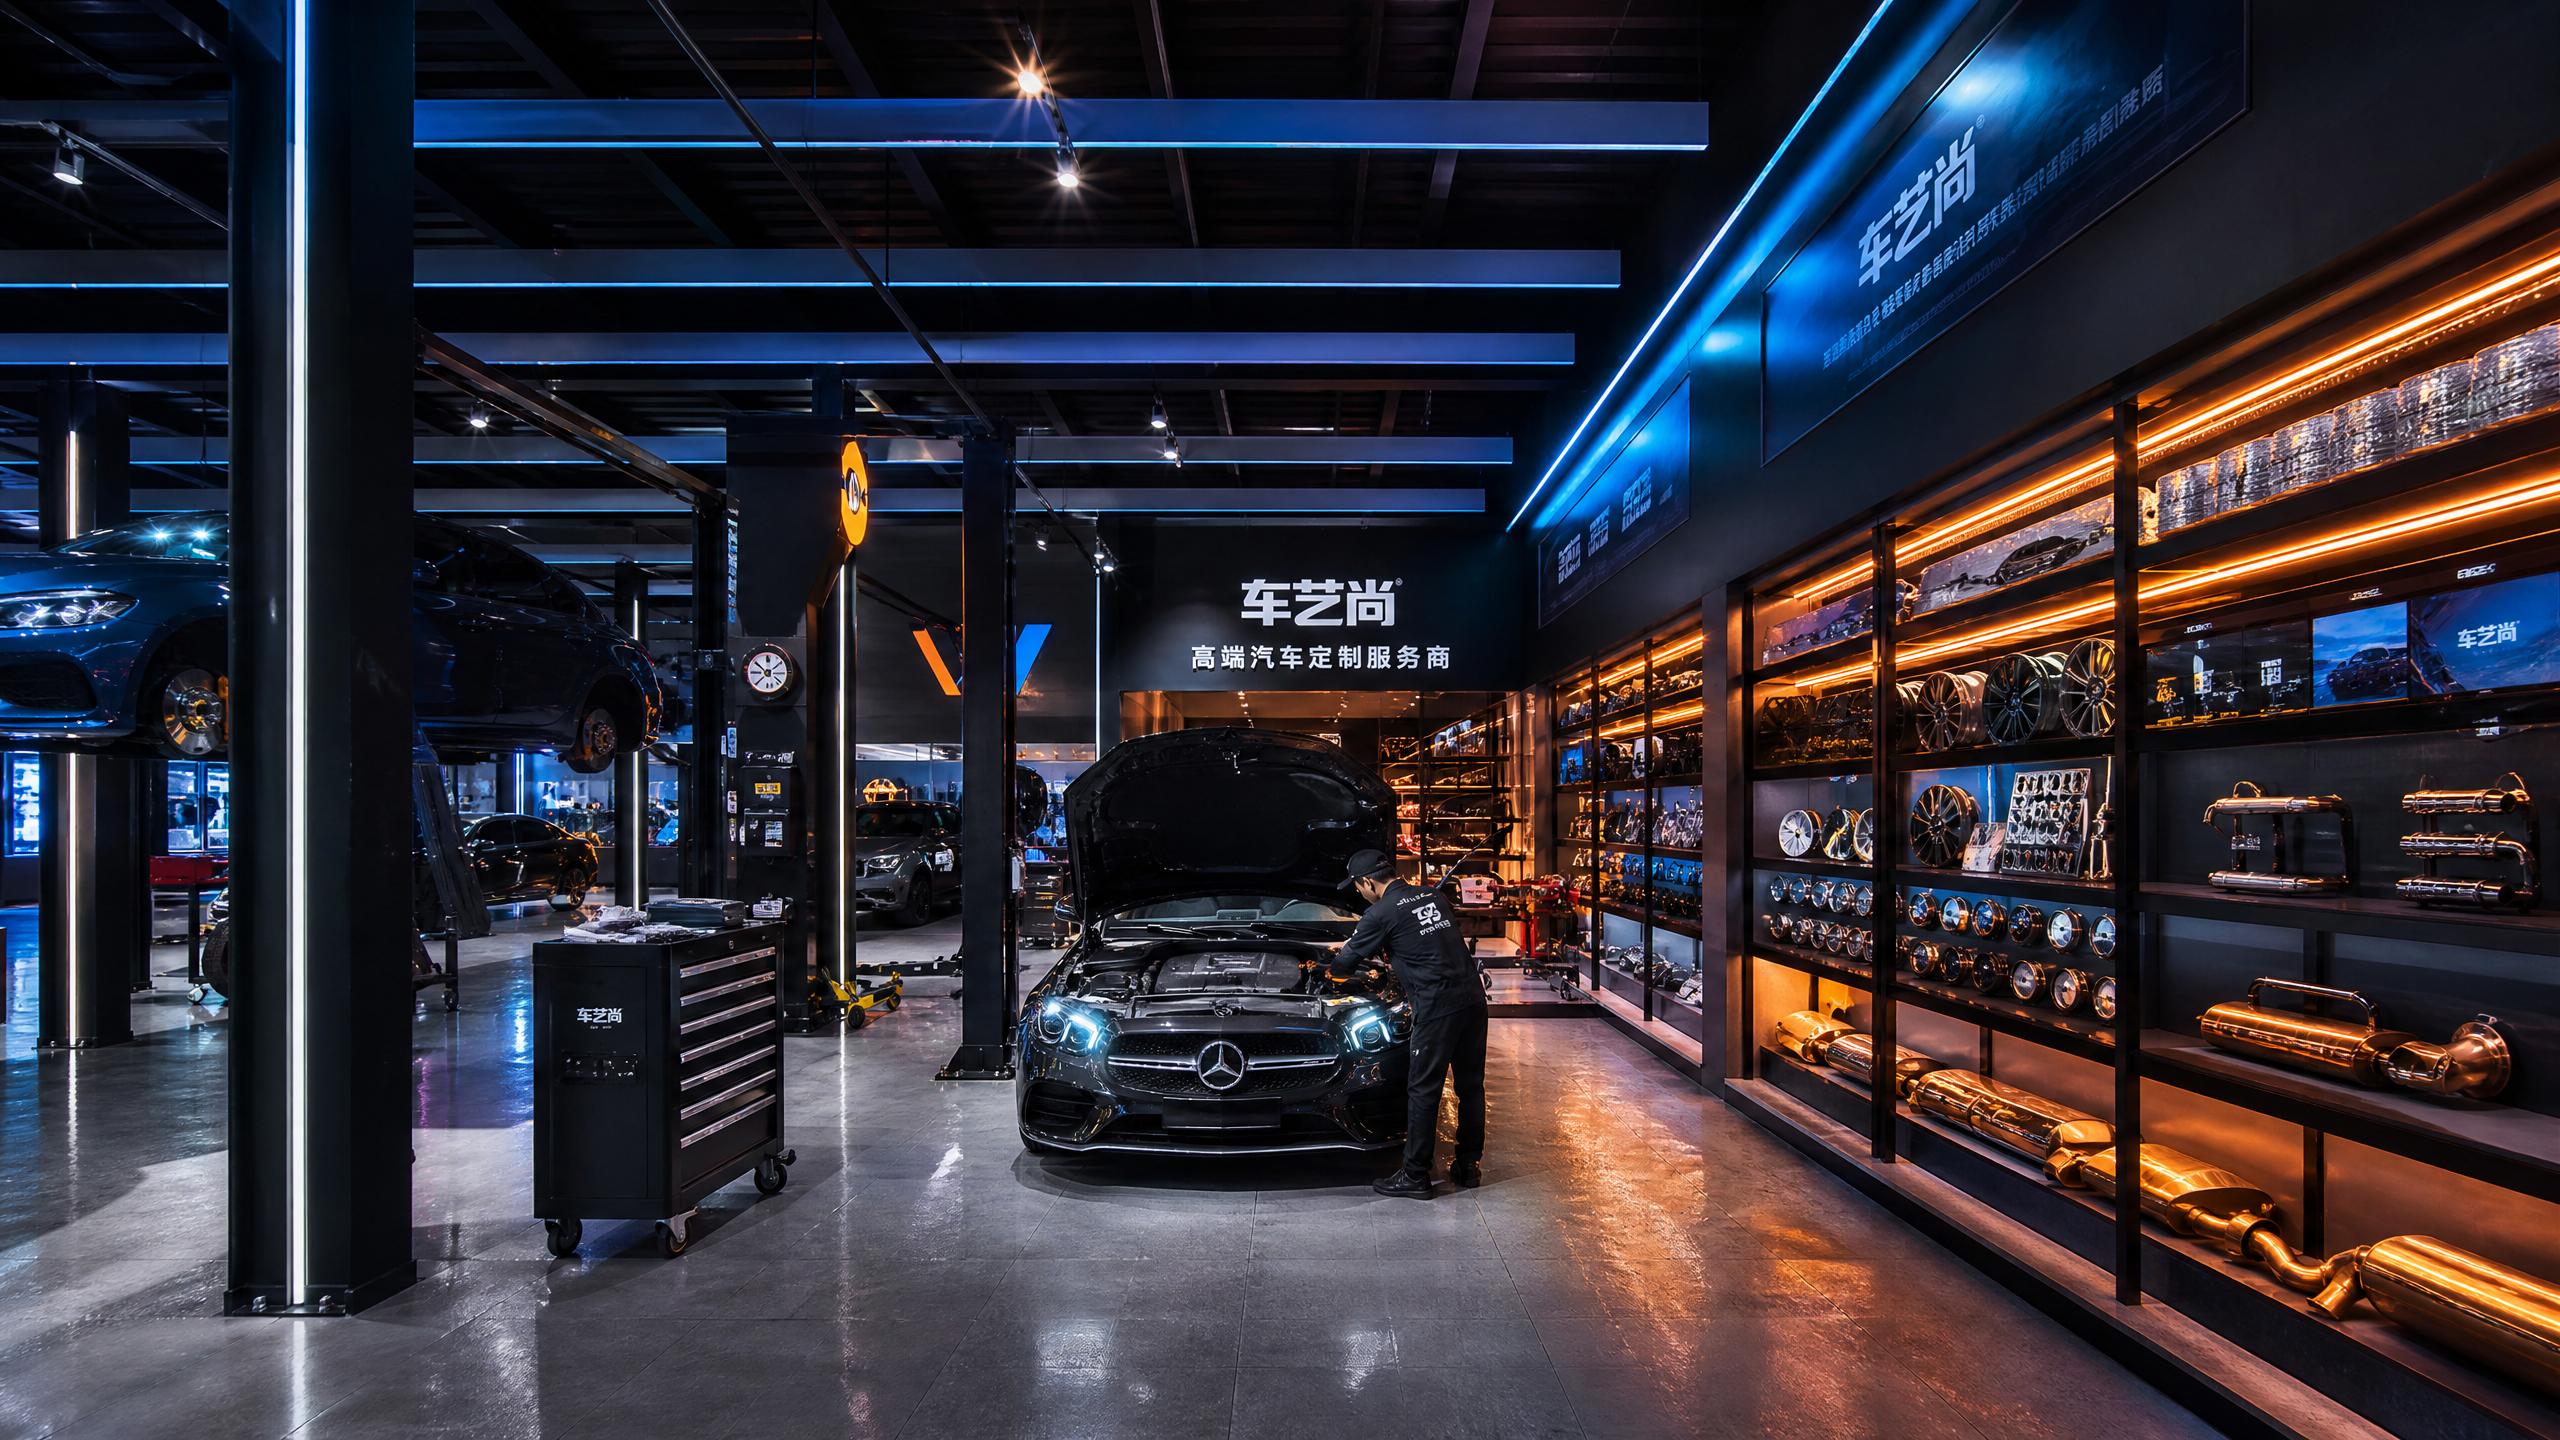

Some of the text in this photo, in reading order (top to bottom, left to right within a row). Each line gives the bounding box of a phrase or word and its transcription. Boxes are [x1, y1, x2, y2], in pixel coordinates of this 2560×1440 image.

[1858, 125, 1977, 288] 车艺尚
[1240, 578, 1396, 627] 车艺尚
[2457, 621, 2517, 649] 车艺尚
[1191, 644, 1451, 670] 高端汽车定制服务商
[576, 1007, 623, 1024] 车艺尚
